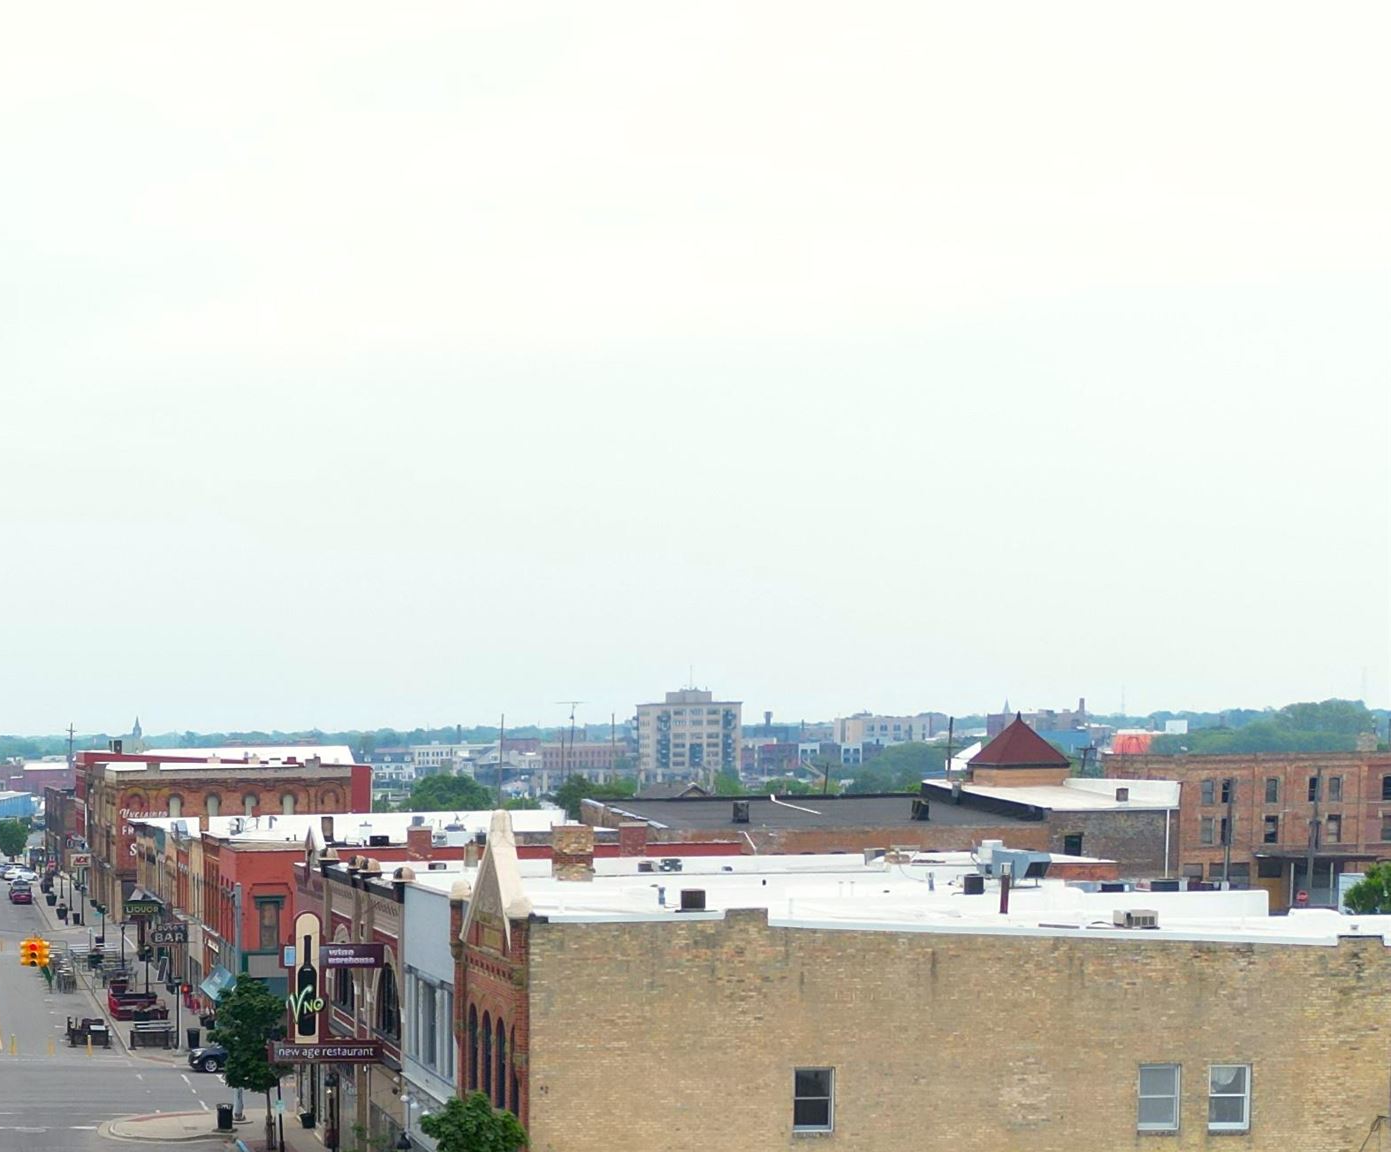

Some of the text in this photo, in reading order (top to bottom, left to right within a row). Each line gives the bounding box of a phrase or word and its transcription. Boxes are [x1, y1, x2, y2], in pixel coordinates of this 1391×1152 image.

[126, 904, 159, 913] LIQUOR
[154, 932, 185, 942] BAR
[278, 1046, 374, 1058] new age restaurant
